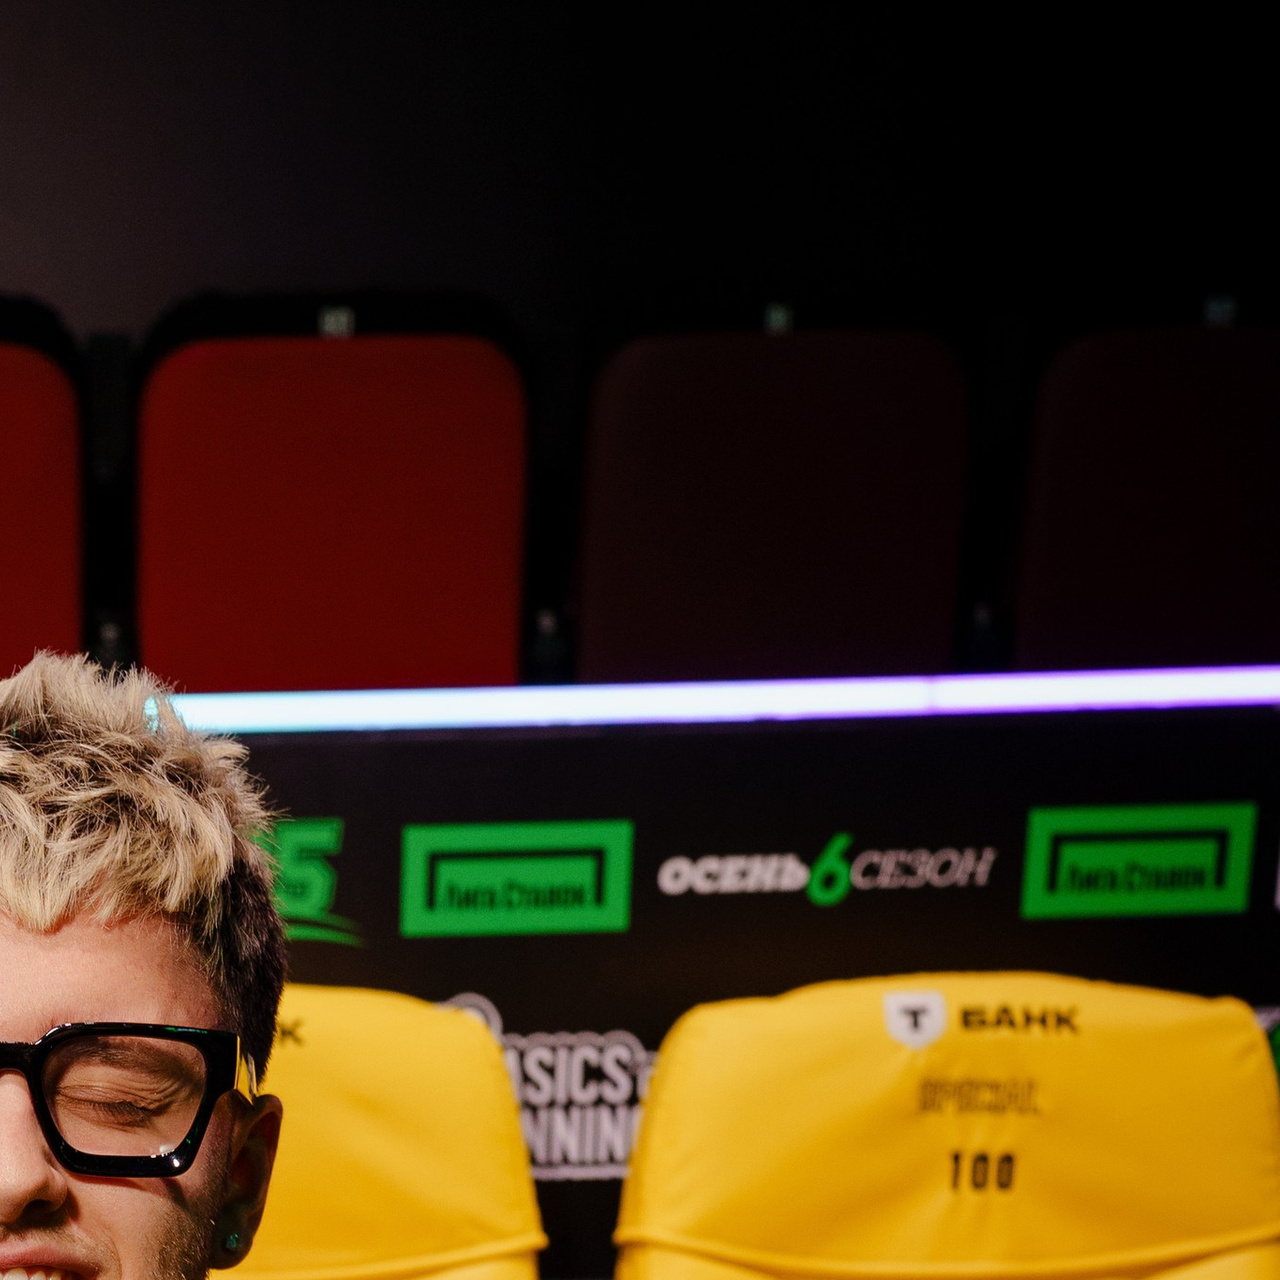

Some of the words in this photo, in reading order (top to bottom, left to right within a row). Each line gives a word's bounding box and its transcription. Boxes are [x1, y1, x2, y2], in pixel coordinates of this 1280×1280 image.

[807, 831, 853, 907] 6
[960, 1004, 1080, 1034] БАНК
[951, 1151, 1015, 1191] 100
